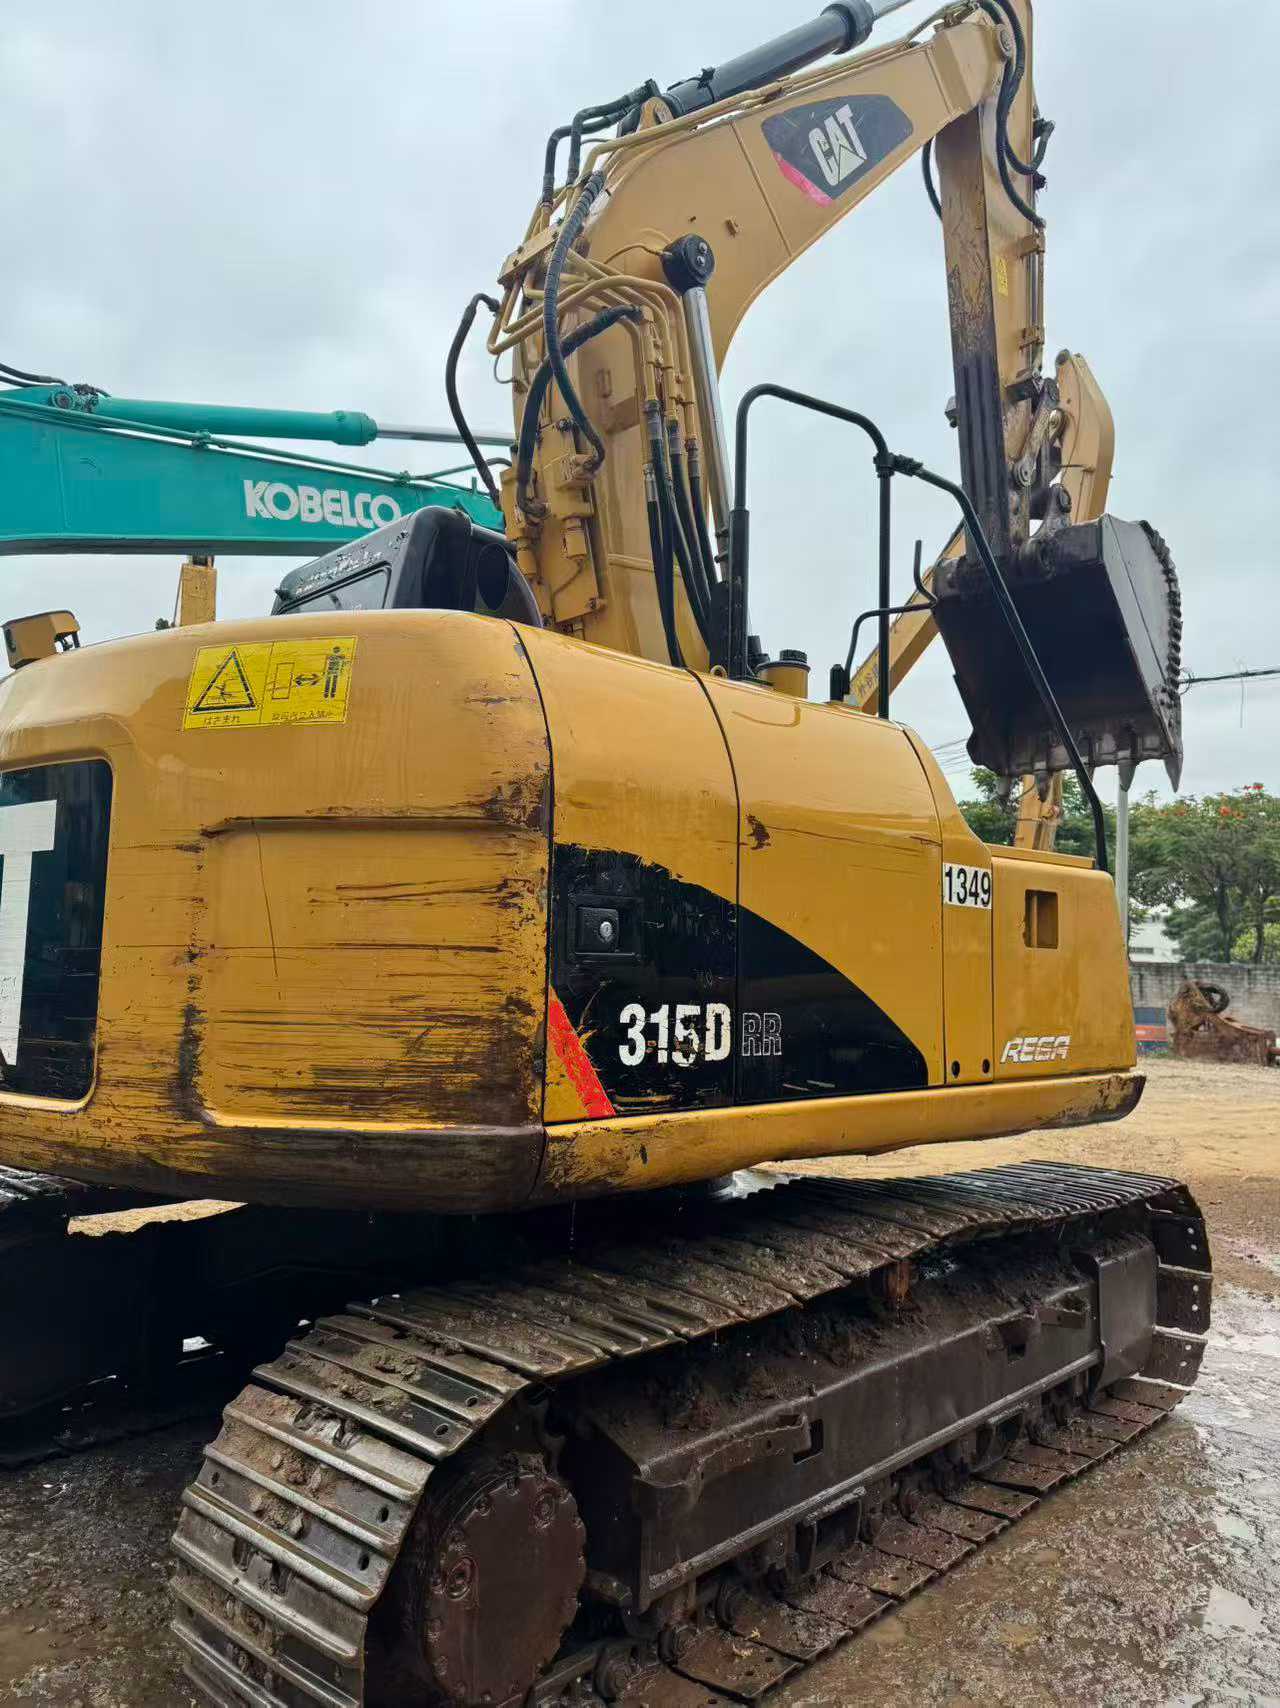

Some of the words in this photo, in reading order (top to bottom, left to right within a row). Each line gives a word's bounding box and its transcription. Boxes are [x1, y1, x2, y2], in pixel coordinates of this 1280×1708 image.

[808, 104, 867, 186] CAT
[243, 479, 401, 529] KOBELCO
[945, 866, 991, 907] 1349
[618, 1003, 731, 1067] 315D
